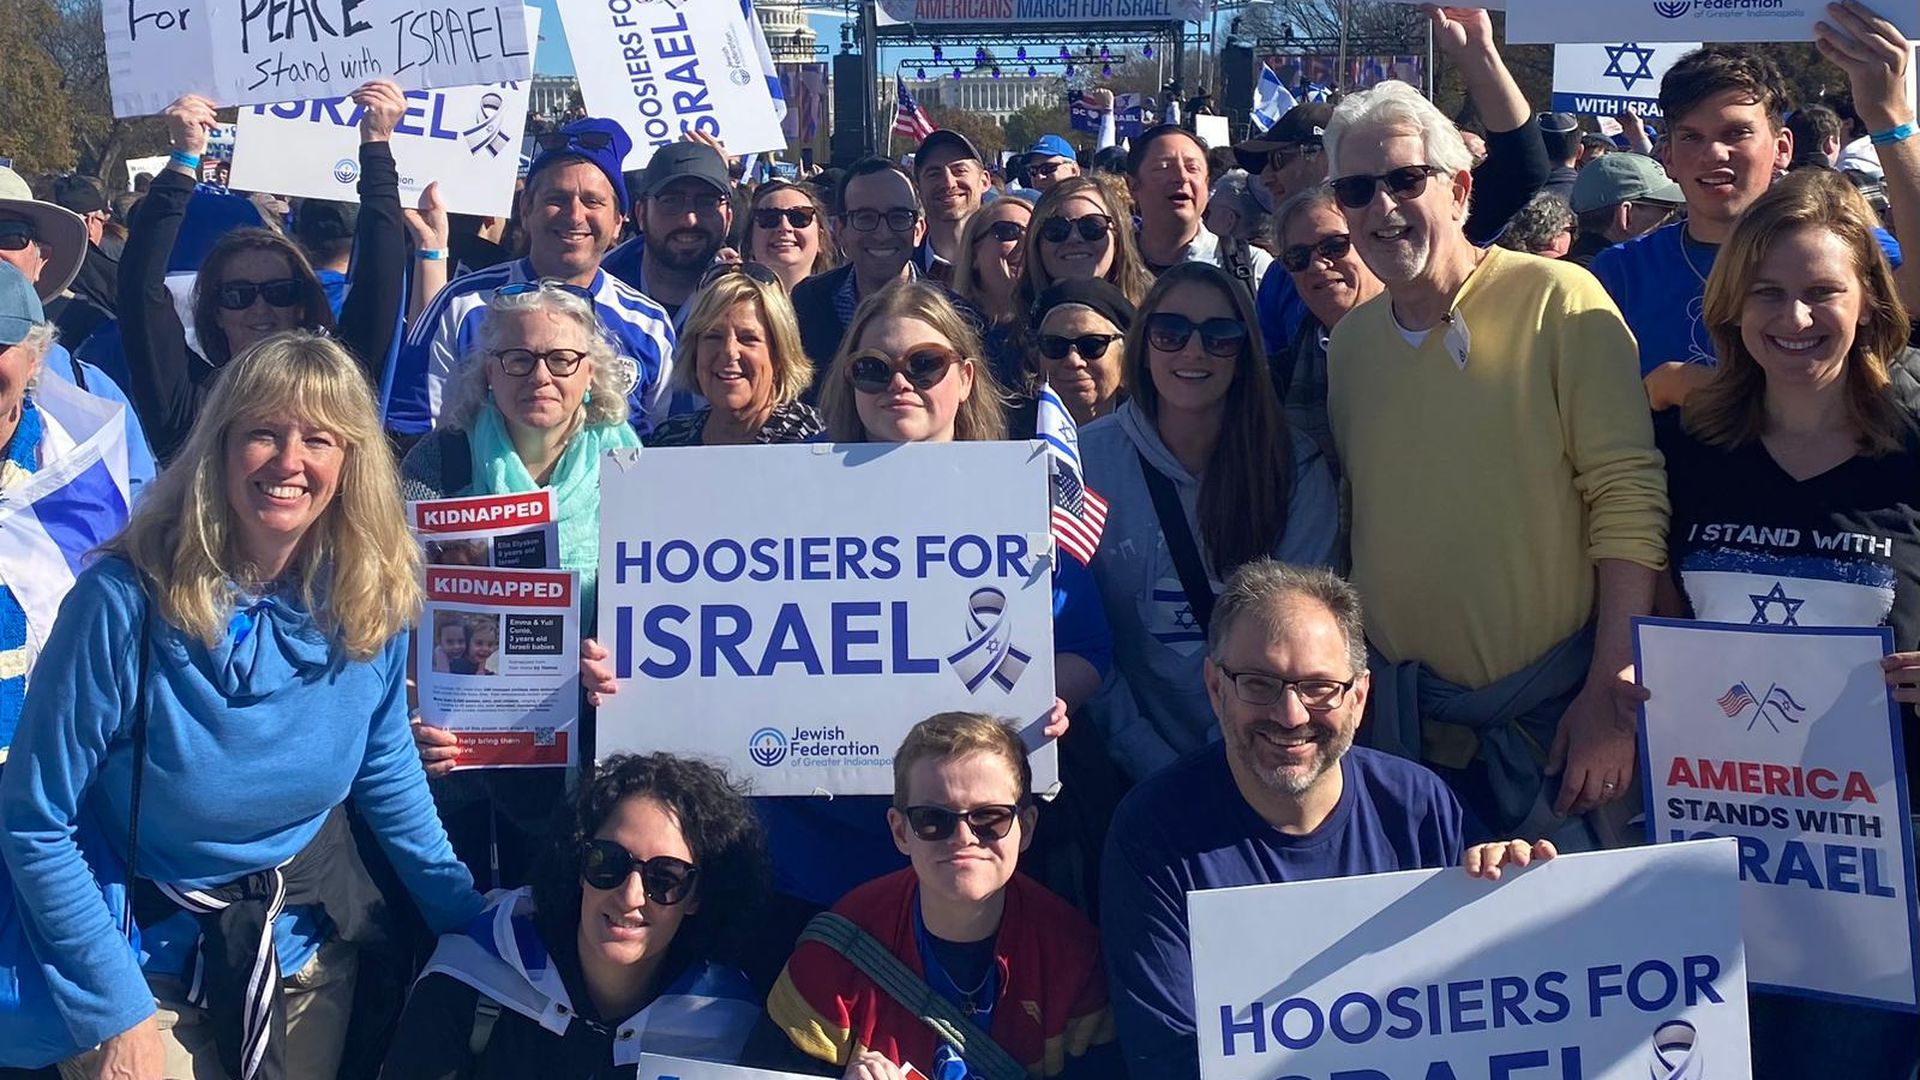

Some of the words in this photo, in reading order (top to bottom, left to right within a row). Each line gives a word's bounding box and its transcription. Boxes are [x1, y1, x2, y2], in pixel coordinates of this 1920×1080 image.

[608, 0, 637, 28] FO
[914, 0, 1012, 19] AMERICANS
[1016, 0, 1078, 18] MARCH
[1082, 0, 1112, 17] FOR
[1116, 0, 1171, 17] ISRAEL
[1706, 9, 1744, 18] Greater
[1748, 8, 1805, 18] Indianapolis
[127, 0, 191, 40] For
[240, 0, 372, 53] PEACE
[248, 50, 330, 91] stand
[340, 46, 381, 78] with
[390, 5, 530, 76] ISRAEL
[651, 12, 724, 147] SRAEL
[1575, 97, 1619, 115] WITH
[423, 500, 543, 526] KIDNAPPED
[1688, 524, 1698, 542] I
[1702, 524, 1800, 548] STAND
[1812, 530, 1892, 558] WITH
[615, 536, 901, 584] HOOSIERS
[916, 534, 1030, 579] FOR
[434, 576, 564, 598] KIDNAPPED
[615, 601, 940, 680] ISRAEL
[478, 737, 499, 746] bring
[500, 737, 520, 745] them
[790, 741, 879, 757] Federation
[791, 726, 845, 741] Jewish
[791, 757, 800, 767] of
[803, 757, 841, 767] Greater
[843, 756, 894, 769] Indianapo
[1667, 757, 1878, 804] AMERICA
[1667, 797, 1790, 830] STANDS
[1795, 808, 1882, 838] WITH
[1670, 829, 1896, 899] RAEL
[1220, 970, 1571, 1057] HOOSIERS
[1586, 954, 1725, 1018] FOR
